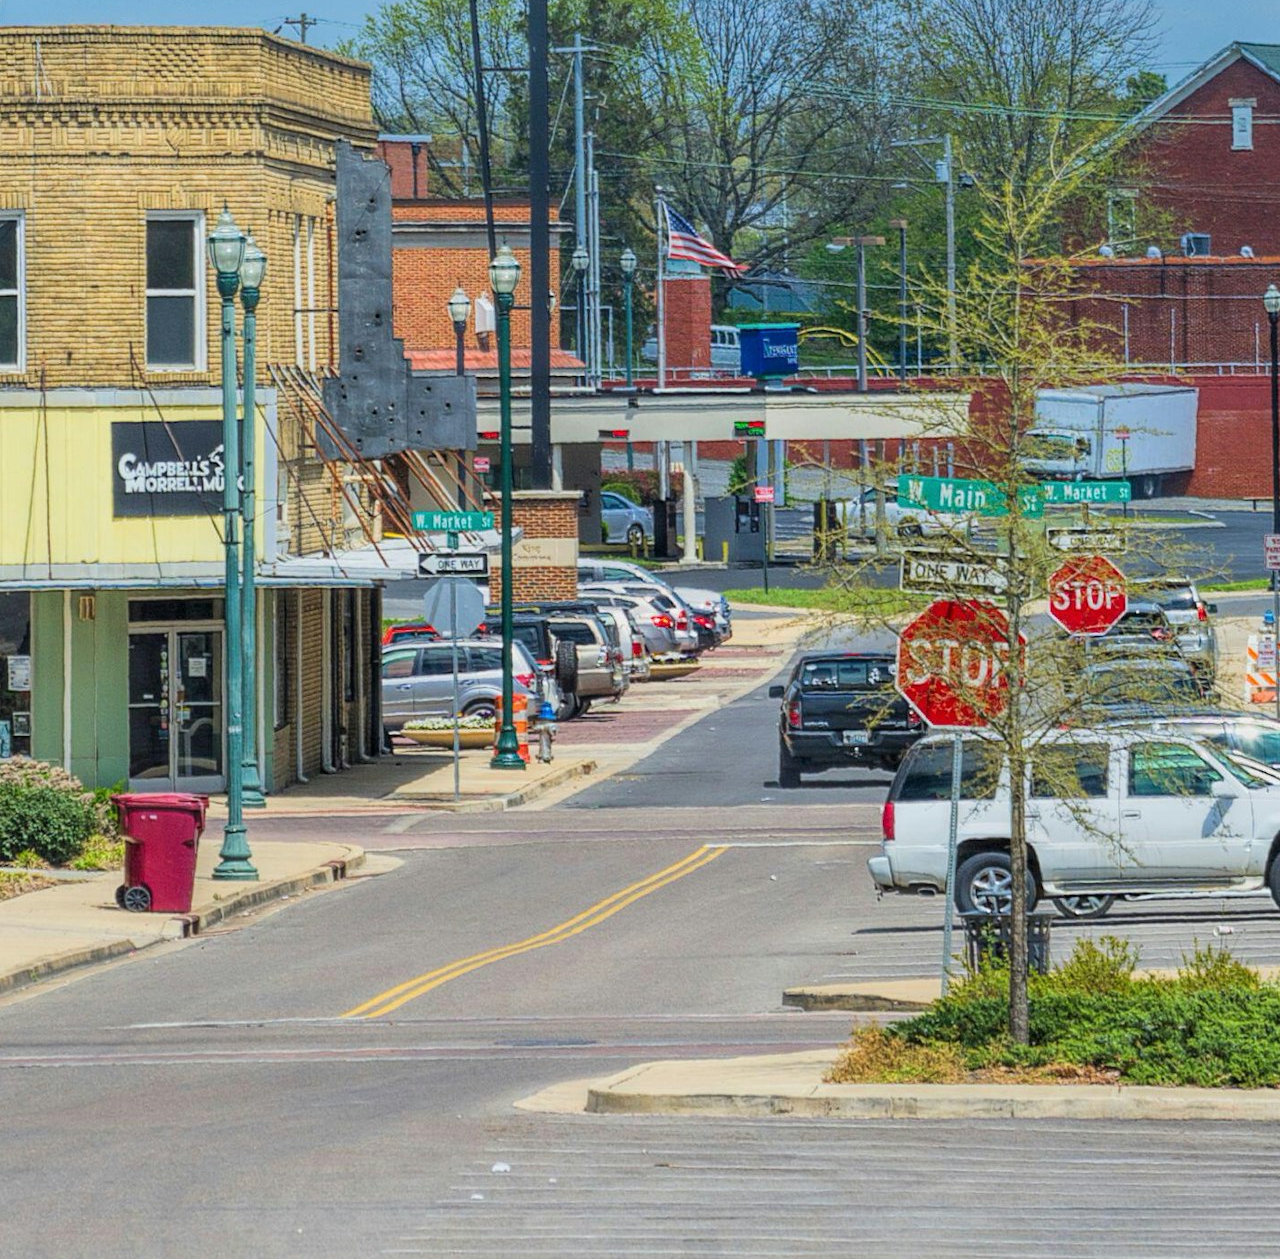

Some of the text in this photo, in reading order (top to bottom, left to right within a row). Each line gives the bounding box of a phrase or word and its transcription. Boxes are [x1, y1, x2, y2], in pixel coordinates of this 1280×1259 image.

[203, 475, 245, 492] MUC
[908, 480, 1037, 512] W. Main St
[1045, 485, 1128, 500] W. Market St
[415, 514, 491, 529] W. Market St
[438, 559, 480, 570] ONE WAY
[915, 563, 990, 583] ONE WAY
[1053, 579, 1121, 610] STOP
